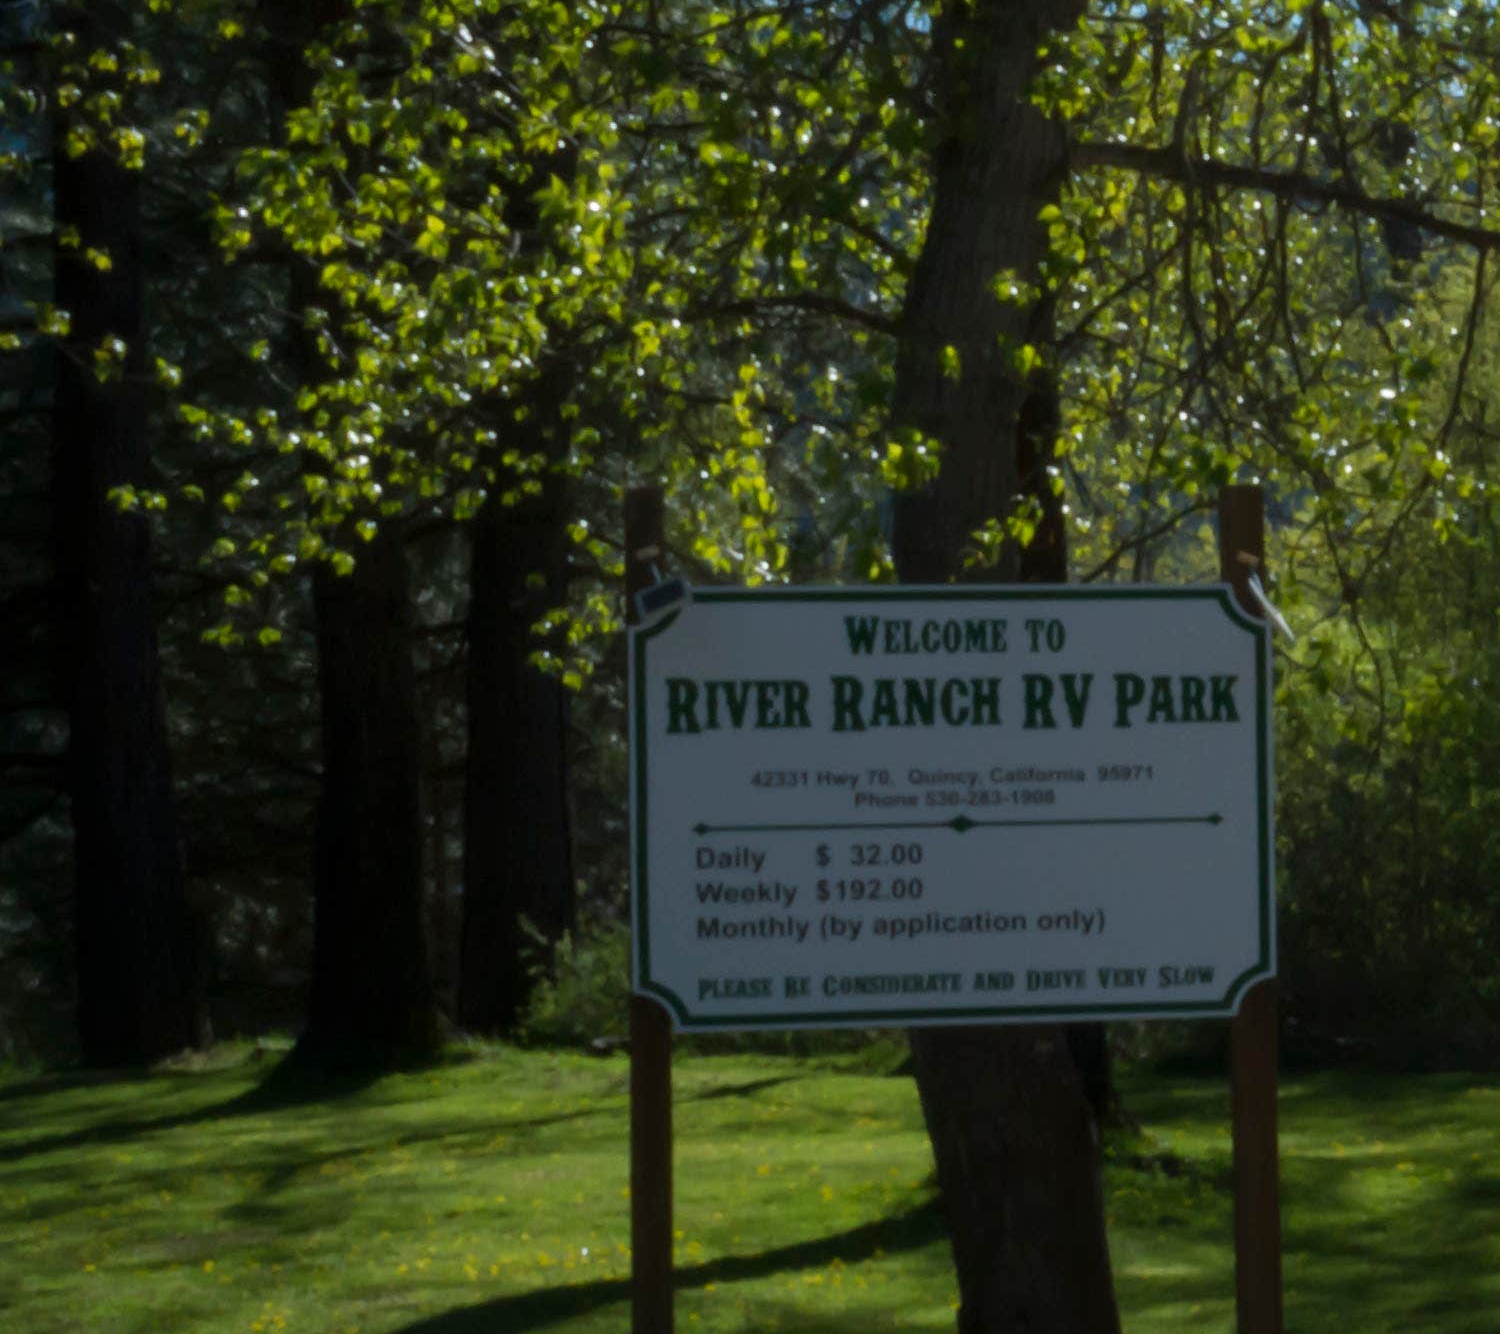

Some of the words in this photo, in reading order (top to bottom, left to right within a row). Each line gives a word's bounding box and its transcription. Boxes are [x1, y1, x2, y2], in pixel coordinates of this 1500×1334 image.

[845, 615, 1007, 655] WELCOME
[1026, 618, 1065, 652] TO
[666, 677, 811, 735] RIVER
[831, 676, 1001, 732] RANCH
[1022, 673, 1094, 729] RV
[1114, 674, 1239, 728] PARK
[818, 769, 861, 789] Hwy
[990, 765, 1086, 785] California
[854, 790, 919, 808] Phone
[695, 846, 766, 875] Daily
[816, 845, 831, 868] $
[850, 843, 922, 867] 32.00
[695, 881, 798, 908] Weekly
[816, 878, 922, 903] $192.00
[695, 915, 810, 943] Monthly
[819, 913, 866, 941] (by
[872, 910, 1028, 941] application
[1036, 908, 1106, 936] only)
[698, 976, 772, 1001] PLEASE
[784, 975, 811, 998] BE
[822, 972, 962, 997] CONSIDERATE
[973, 971, 1015, 991] AND
[1026, 968, 1088, 991] DRIVE
[1098, 967, 1147, 989] VERY
[1158, 965, 1214, 988] SLOW
